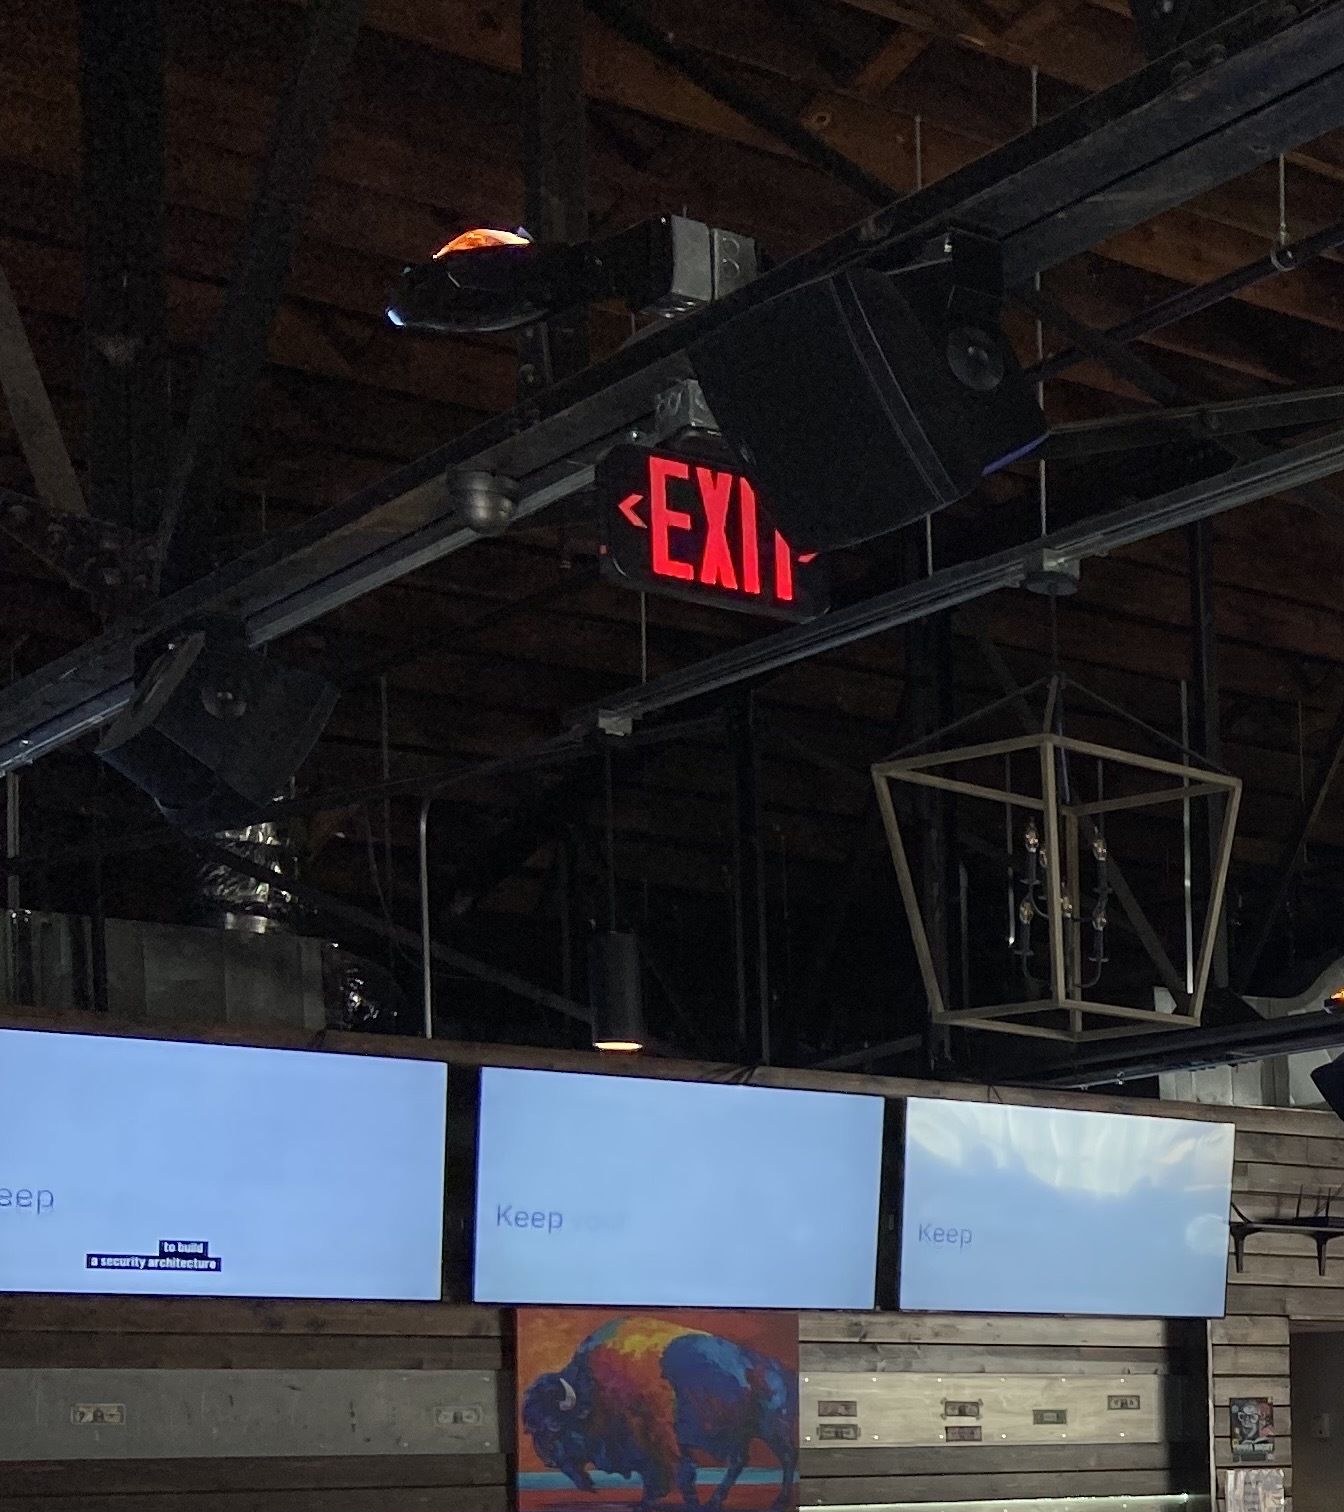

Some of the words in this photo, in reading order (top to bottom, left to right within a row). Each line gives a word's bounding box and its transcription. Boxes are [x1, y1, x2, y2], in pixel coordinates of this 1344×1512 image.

[496, 1203, 564, 1235] Keep
[919, 1223, 973, 1249] Keep
[163, 1241, 176, 1253] to
[177, 1241, 204, 1254] build
[100, 1256, 146, 1270] security
[148, 1257, 217, 1270] architecture
